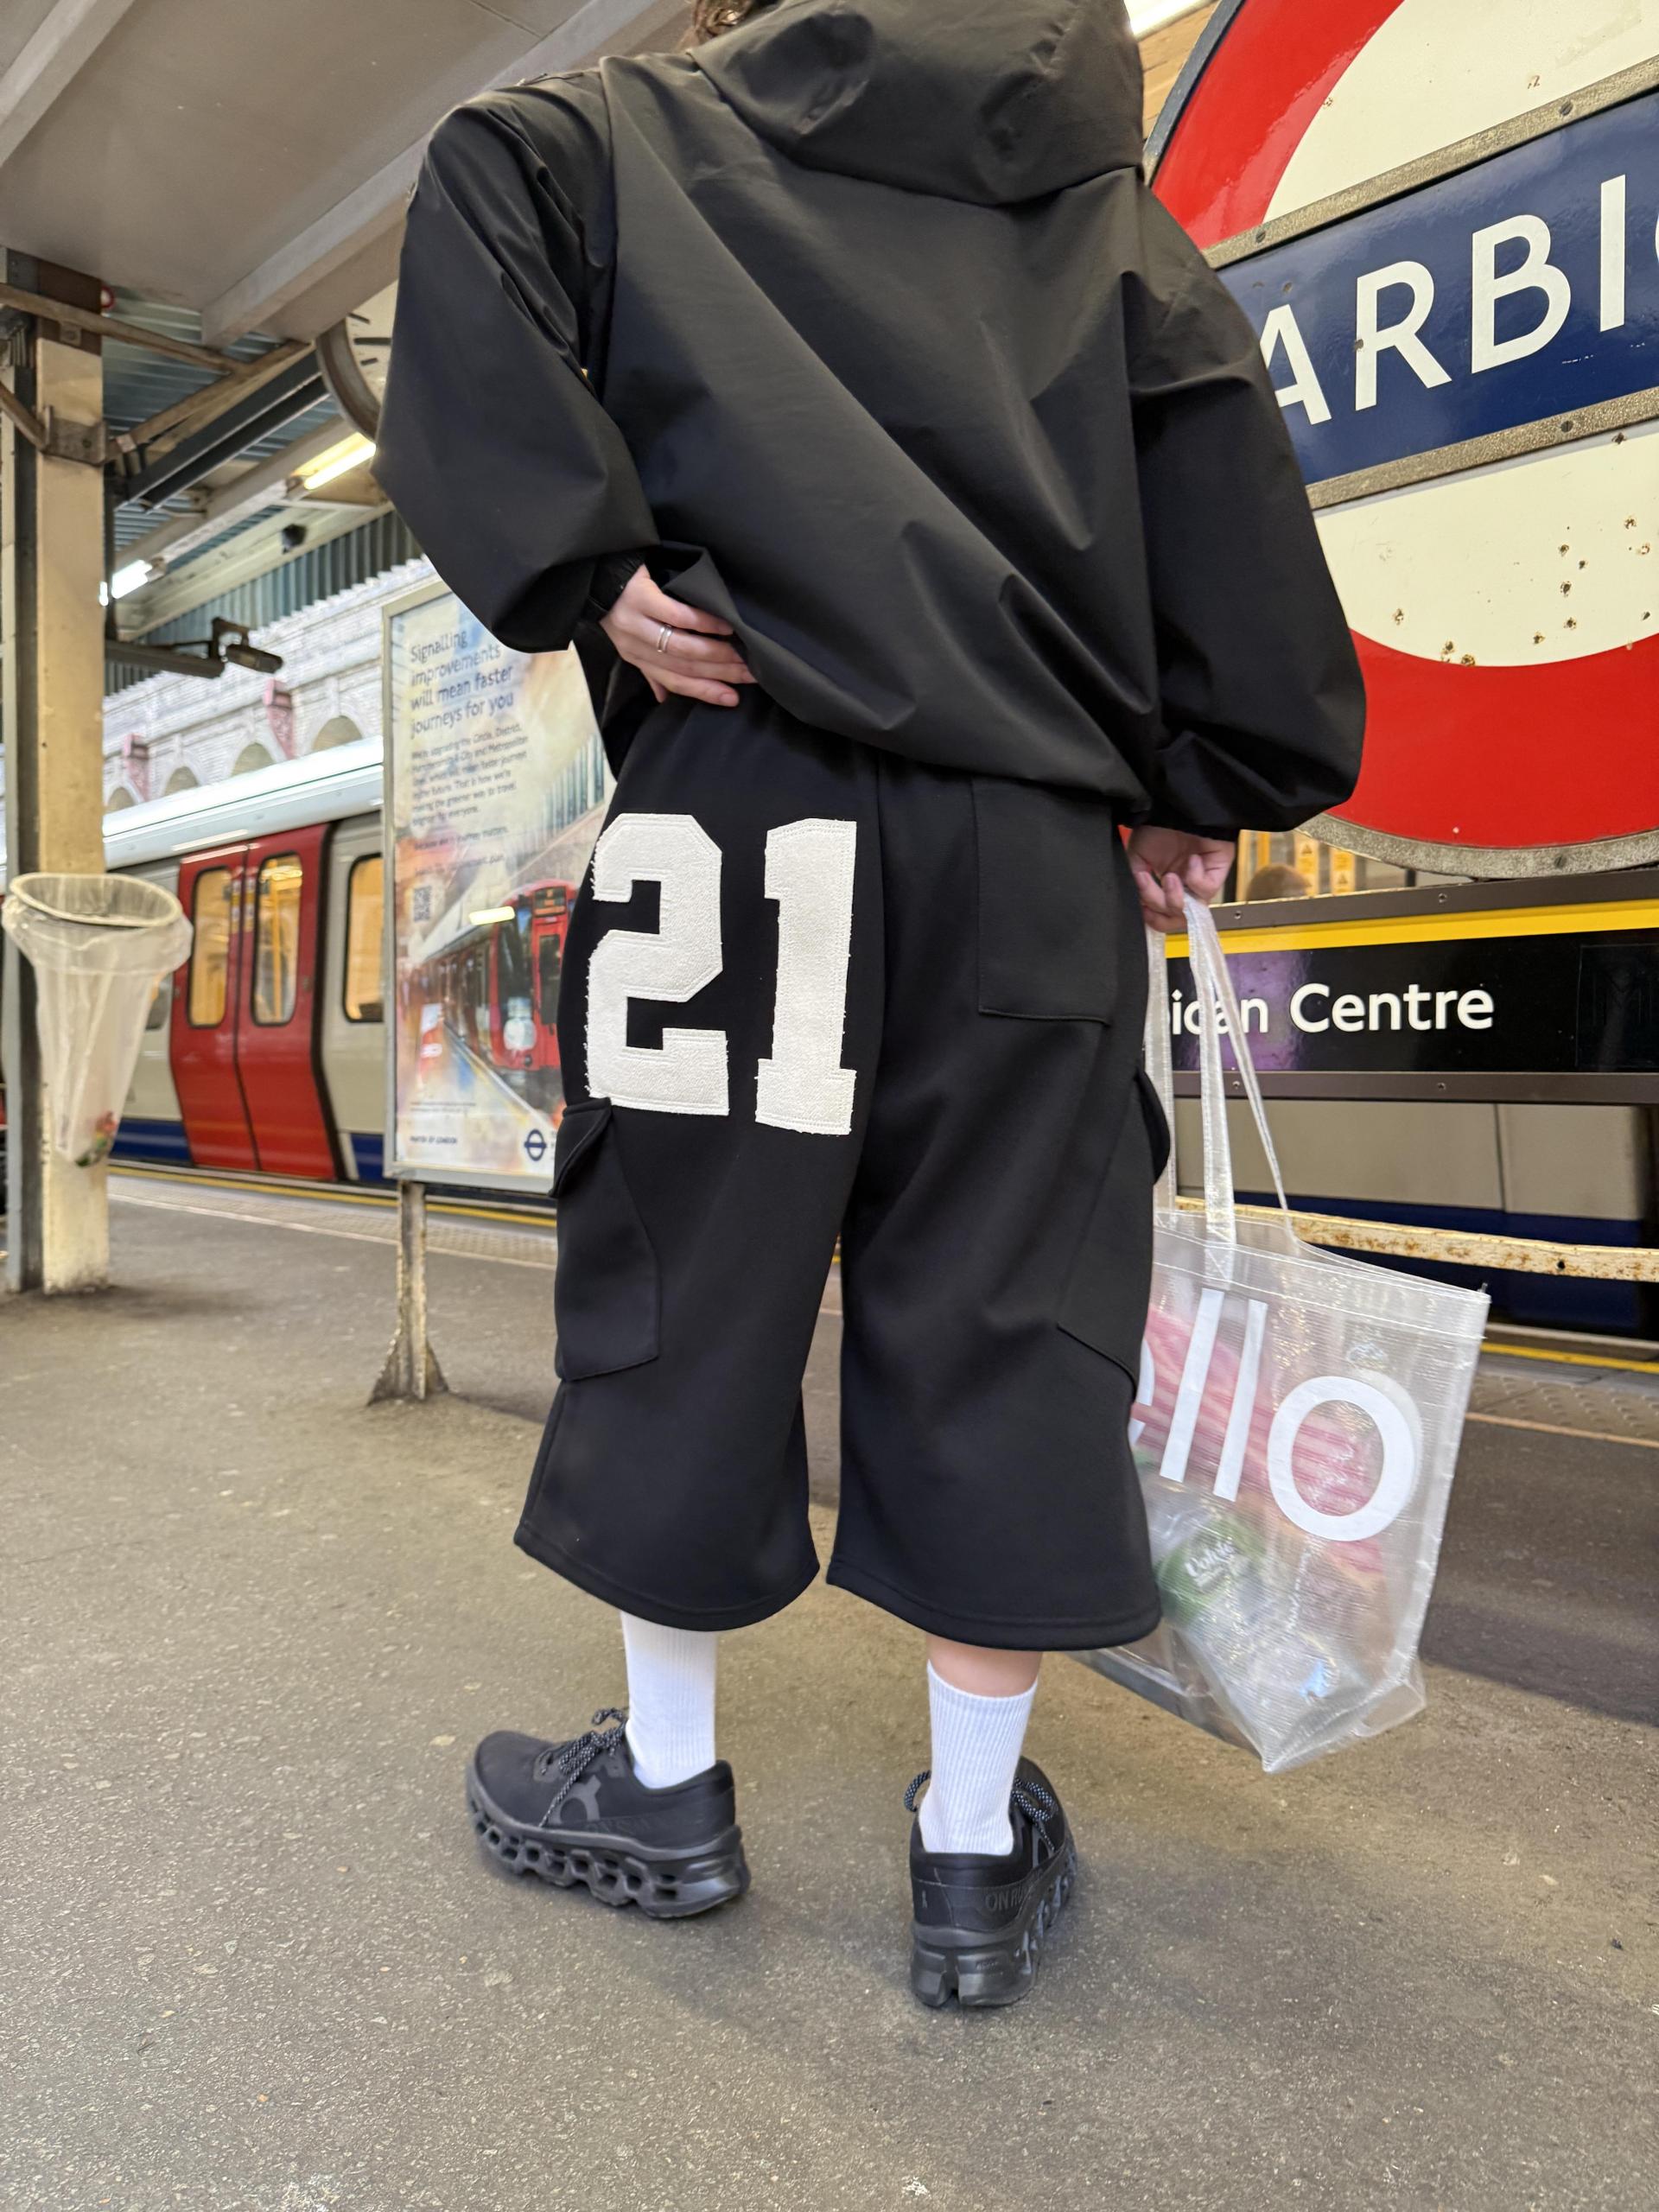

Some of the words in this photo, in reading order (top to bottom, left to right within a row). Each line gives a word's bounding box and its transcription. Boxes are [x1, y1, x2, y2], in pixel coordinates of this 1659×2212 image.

[1260, 175, 1659, 424] ARBI
[410, 631, 467, 664] Signalling
[411, 645, 501, 687] improvements
[410, 689, 433, 710] will
[436, 681, 471, 702] mean
[475, 666, 513, 690] faster
[410, 709, 462, 740] journeys
[465, 701, 486, 719] for
[488, 692, 513, 717] you
[585, 813, 857, 1135] 21
[1290, 982, 1494, 1033] Centre
[1128, 1287, 1415, 1541] llo
